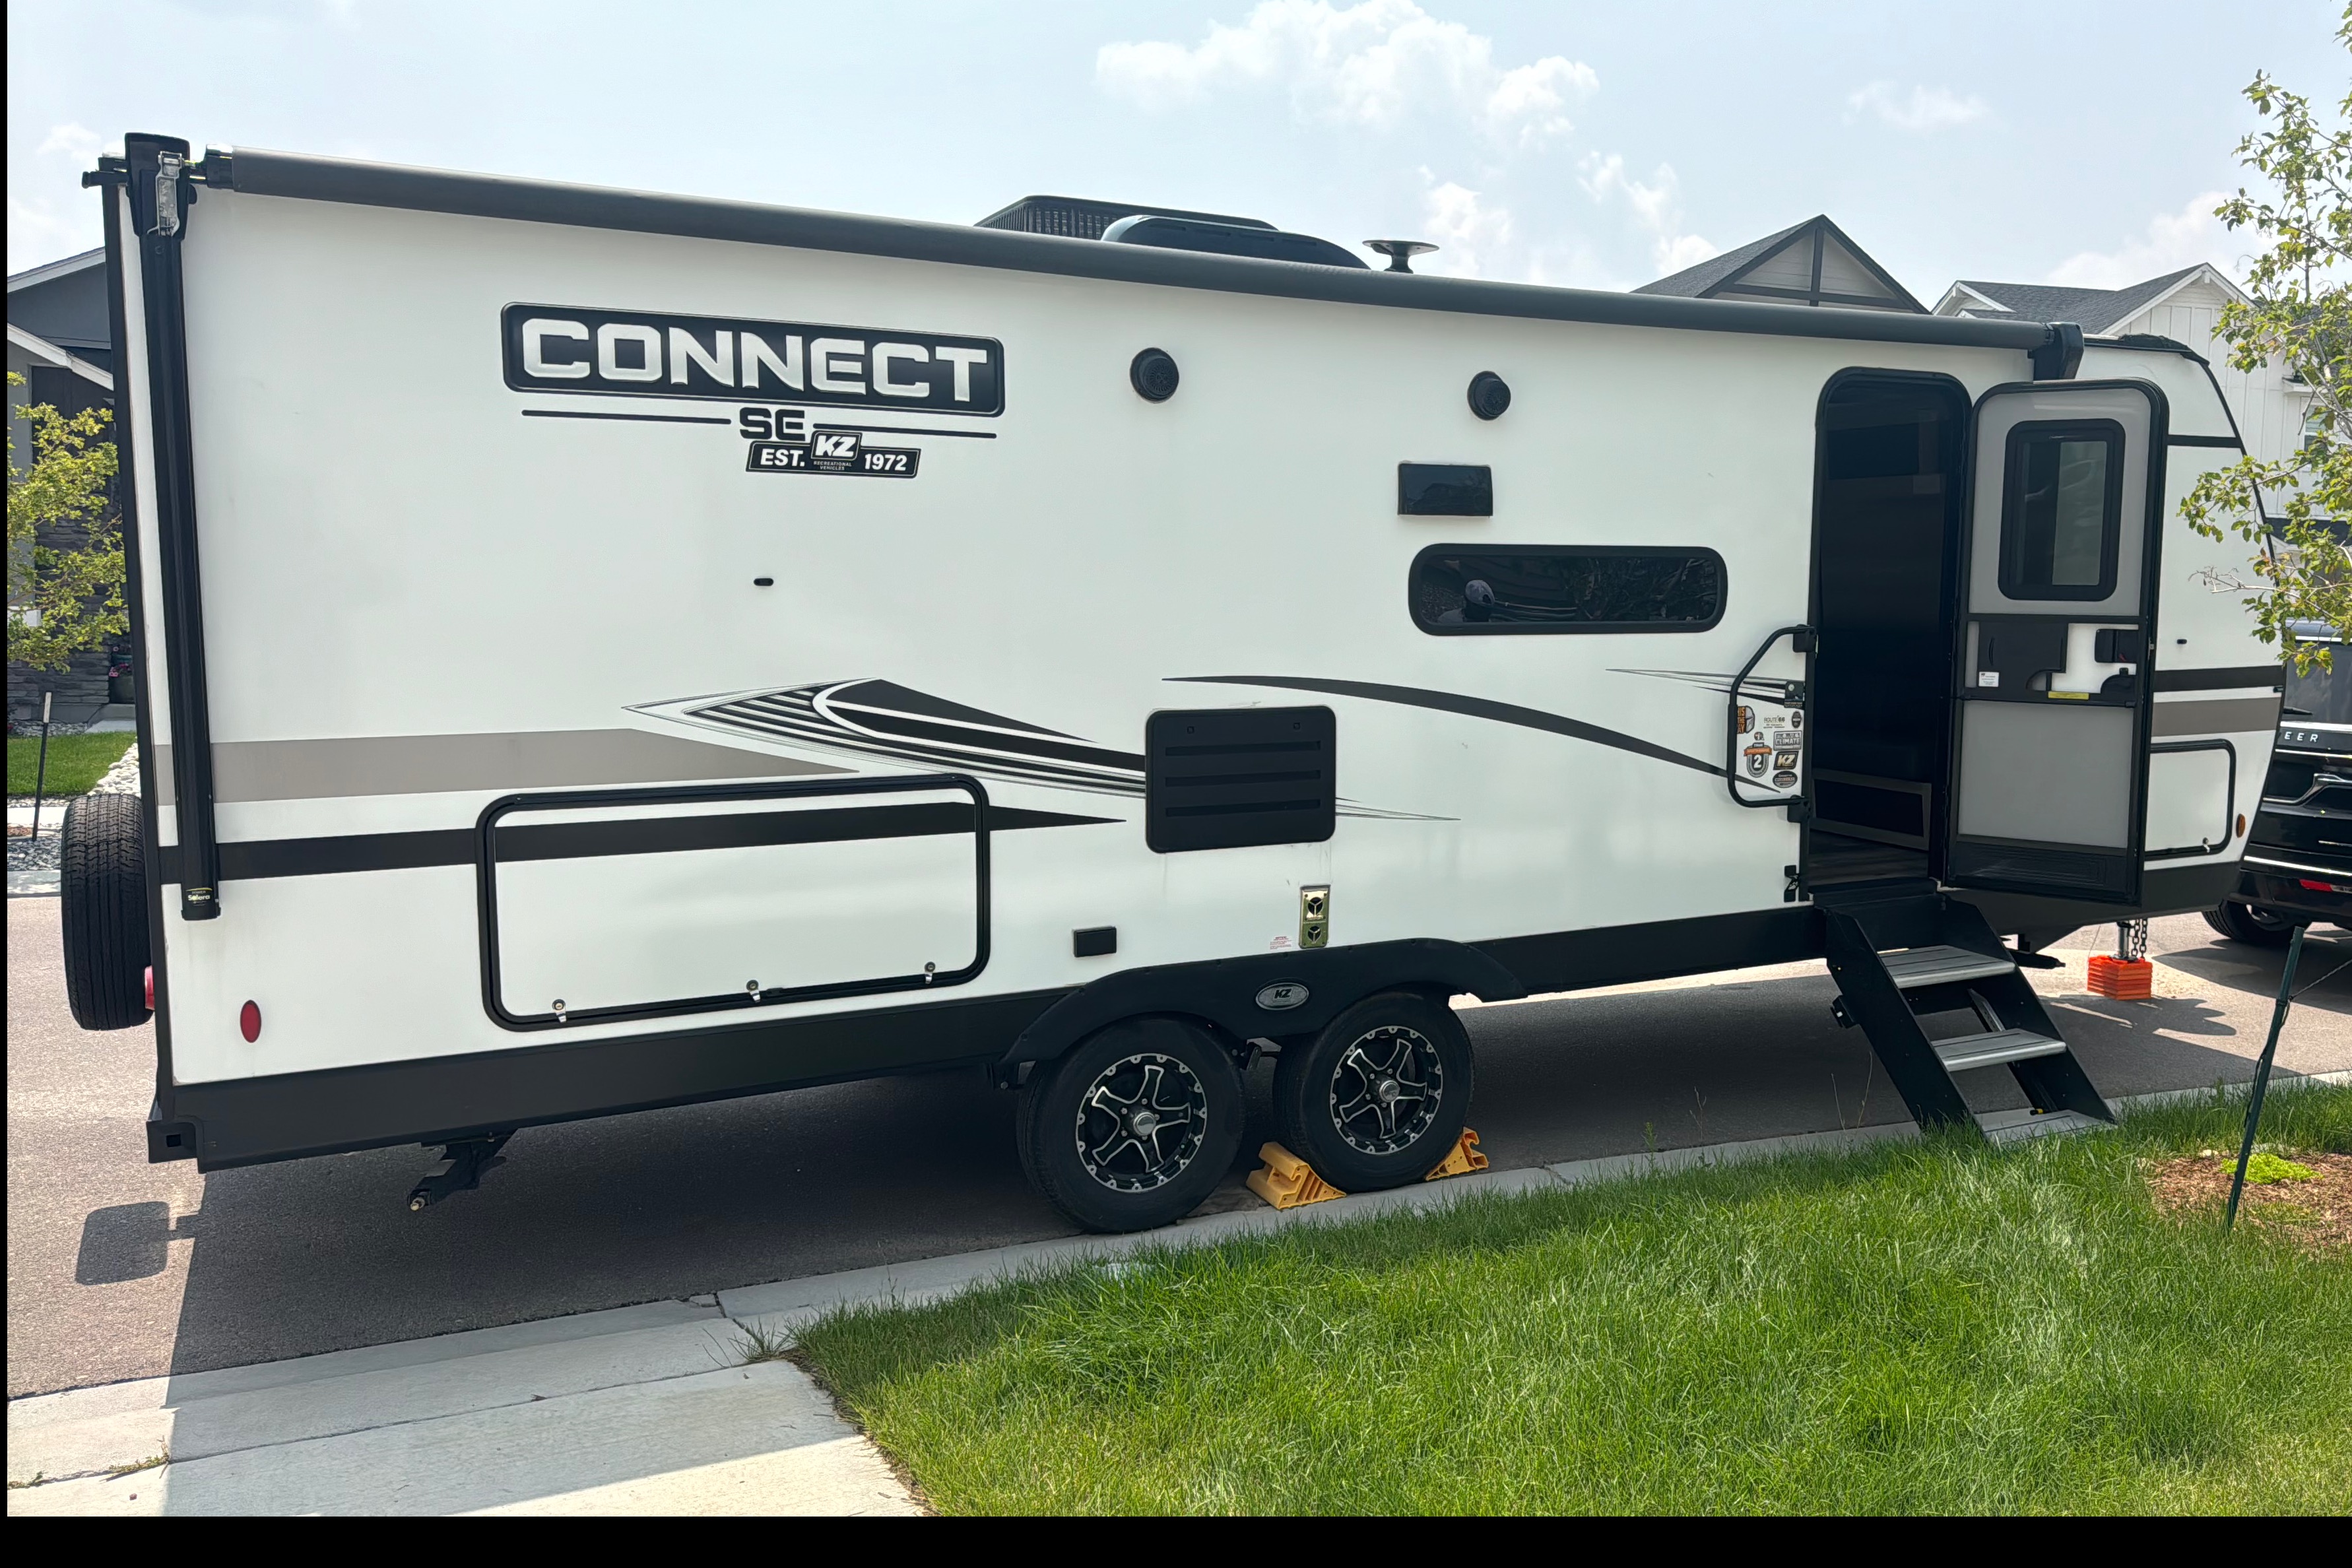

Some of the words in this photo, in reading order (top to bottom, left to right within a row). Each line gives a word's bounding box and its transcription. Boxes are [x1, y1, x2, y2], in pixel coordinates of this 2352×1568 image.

[522, 317, 987, 403] CONNECT
[739, 407, 806, 441] SE
[760, 448, 806, 467] EST.
[815, 435, 857, 457] KZ
[864, 453, 907, 471] 1972
[1753, 754, 1762, 769] 2
[1777, 754, 1796, 767] KZ
[1274, 988, 1292, 999] KZ
